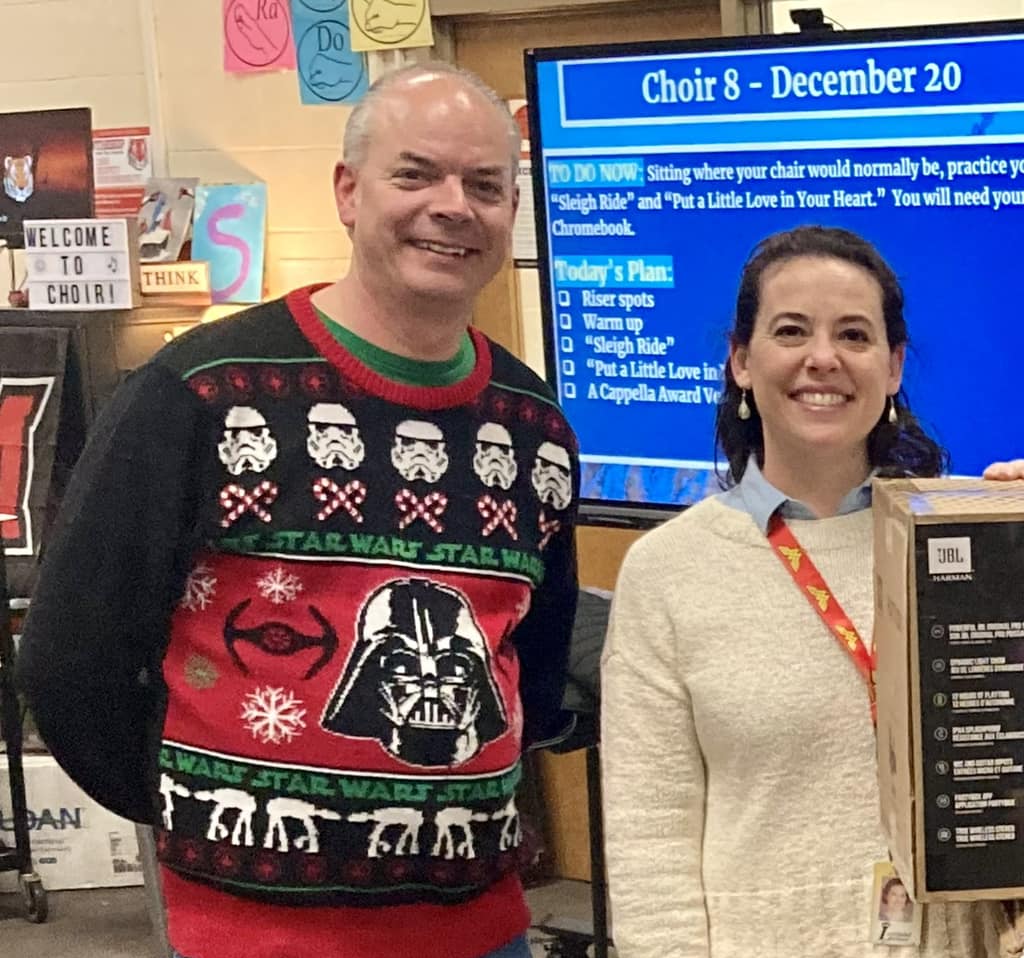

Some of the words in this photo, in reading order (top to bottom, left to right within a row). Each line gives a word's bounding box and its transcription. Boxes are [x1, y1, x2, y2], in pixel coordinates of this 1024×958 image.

[317, 26, 344, 51] Do
[642, 69, 716, 104] Choir
[723, 68, 741, 100] 8
[770, 58, 917, 99] December
[925, 61, 962, 93] 20
[551, 165, 571, 183] TO
[575, 164, 596, 182] DO
[602, 163, 644, 182] NOW:
[647, 164, 692, 186] Sitting
[693, 164, 735, 181] where
[735, 167, 767, 184] your
[770, 160, 805, 179] chair
[808, 159, 850, 178] would
[853, 157, 919, 181] normally
[922, 157, 945, 180] be,
[947, 155, 1008, 180] practice
[638, 192, 662, 210] and
[697, 197, 705, 209] a
[708, 191, 743, 210] Little
[746, 191, 779, 209] Love
[780, 191, 795, 208] in
[797, 190, 830, 208] Your
[892, 189, 921, 207] You
[923, 187, 951, 206] will
[954, 186, 990, 206] need
[26, 226, 111, 248] WELCOME
[552, 219, 635, 237] Chromebook.
[60, 255, 84, 276] TO
[628, 258, 674, 283] Plan:
[142, 271, 200, 287] THINK
[47, 284, 115, 305] CHOIR!
[582, 289, 616, 308] Riser
[618, 292, 656, 312] spots
[582, 313, 624, 331] Warm
[626, 317, 644, 335] up
[619, 365, 628, 378] a
[630, 360, 667, 379] Little
[668, 361, 701, 380] Love
[702, 362, 718, 381] in
[587, 384, 599, 400] A
[600, 383, 656, 406] Cappella
[658, 385, 701, 404] Award
[350, 534, 423, 560] WARS
[426, 543, 499, 566] STAR
[937, 547, 964, 564] JBL
[175, 750, 248, 784] WARS
[251, 770, 336, 796] STAR
[338, 778, 433, 802] WARS
